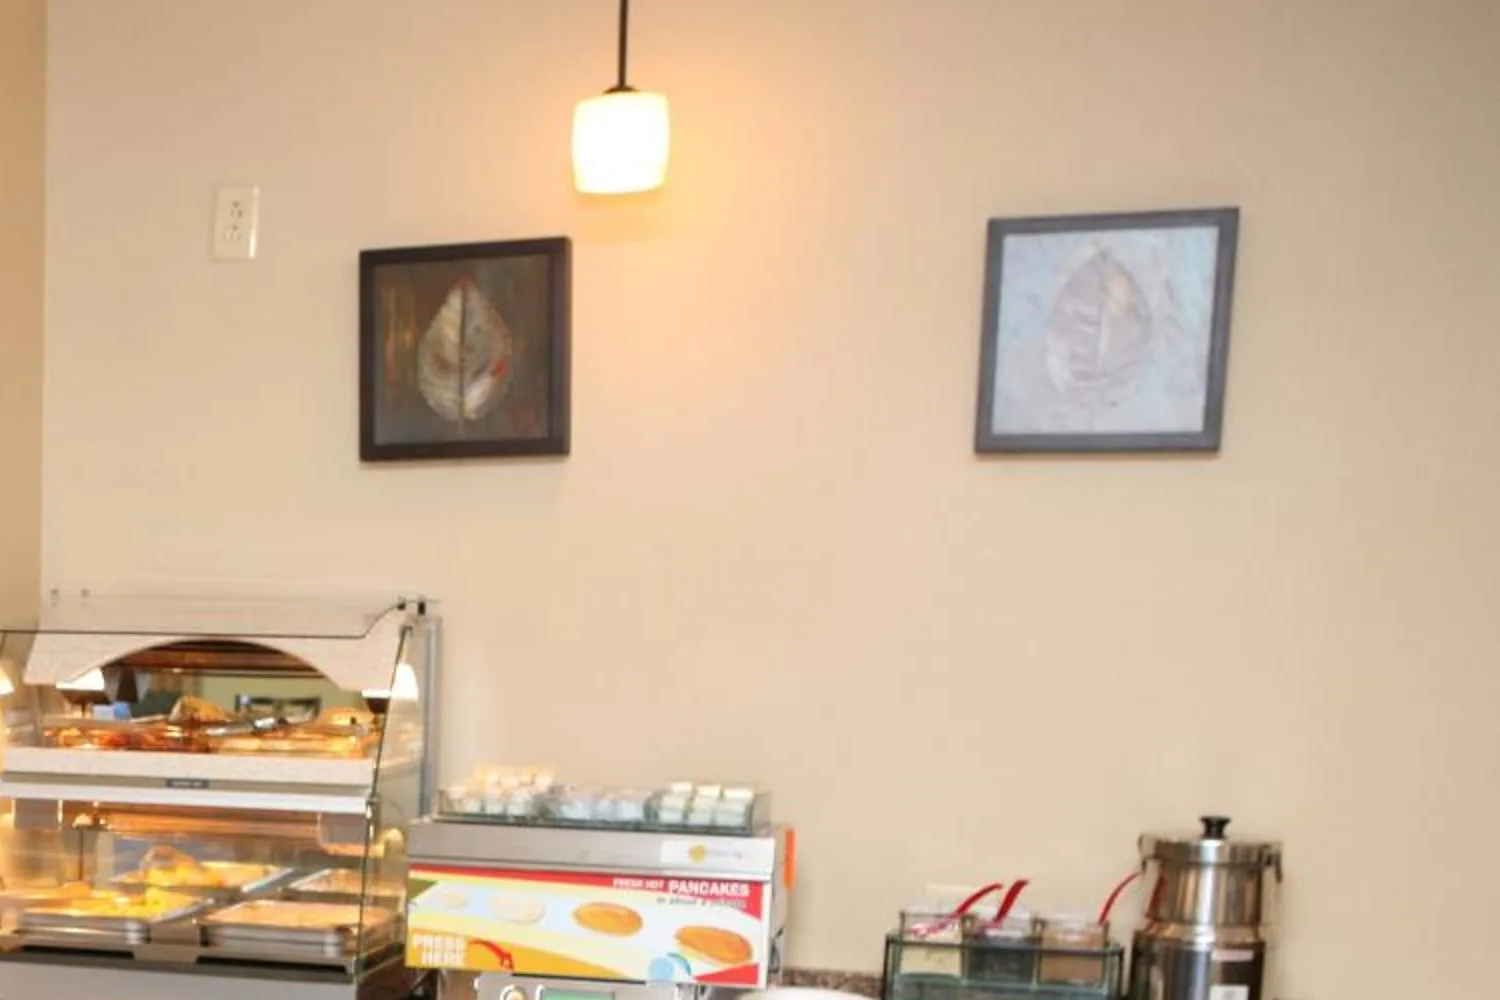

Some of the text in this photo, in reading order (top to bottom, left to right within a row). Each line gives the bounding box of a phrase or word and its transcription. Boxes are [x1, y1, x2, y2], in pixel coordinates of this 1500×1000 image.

[668, 879, 750, 897] PANCAKES
[411, 934, 466, 950] PRESS
[420, 949, 467, 966] HERE
